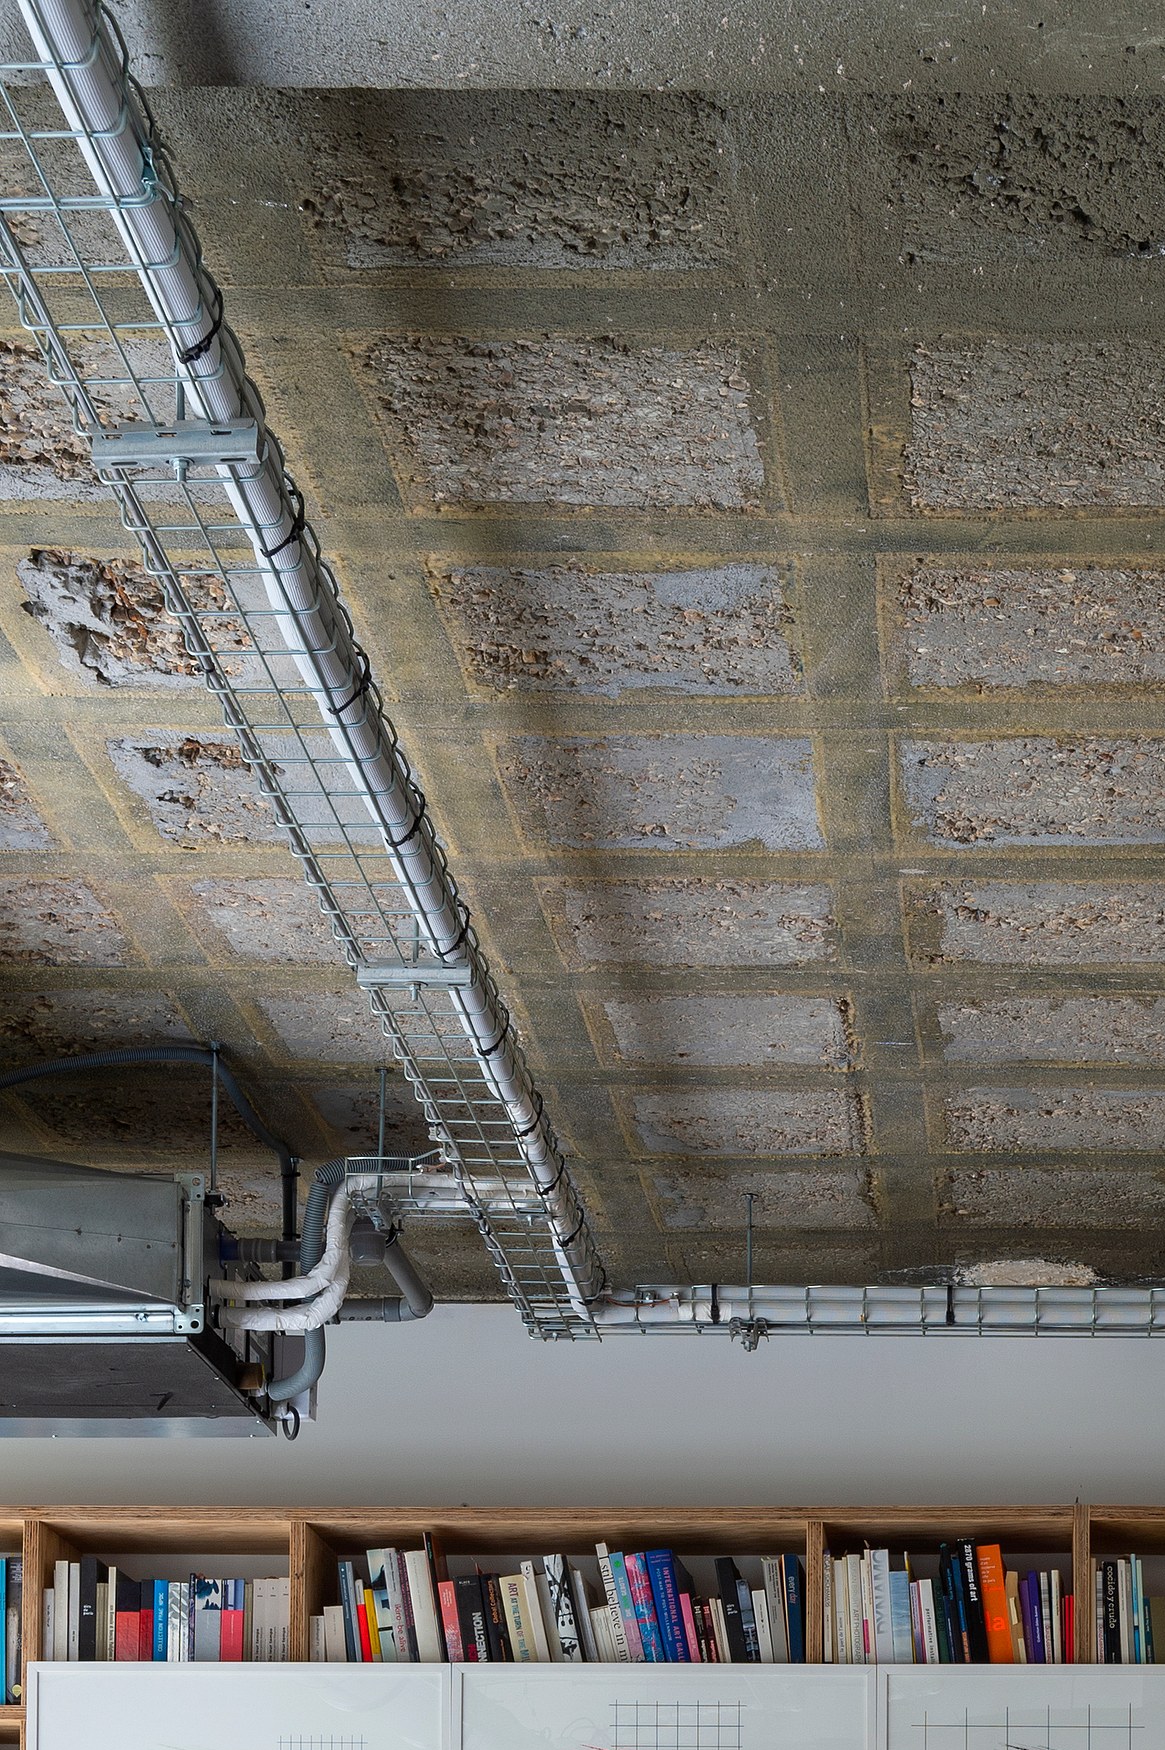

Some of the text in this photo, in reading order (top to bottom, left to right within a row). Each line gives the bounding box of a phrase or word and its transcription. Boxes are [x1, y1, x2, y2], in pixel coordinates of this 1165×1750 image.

[964, 1544, 973, 1560] 2870
[966, 1561, 976, 1581] grams
[1106, 1565, 1117, 1596] cocido
[507, 1582, 517, 1597] ART
[662, 1566, 678, 1624] INTERNATIONAL
[1107, 1602, 1117, 1629] crudo
